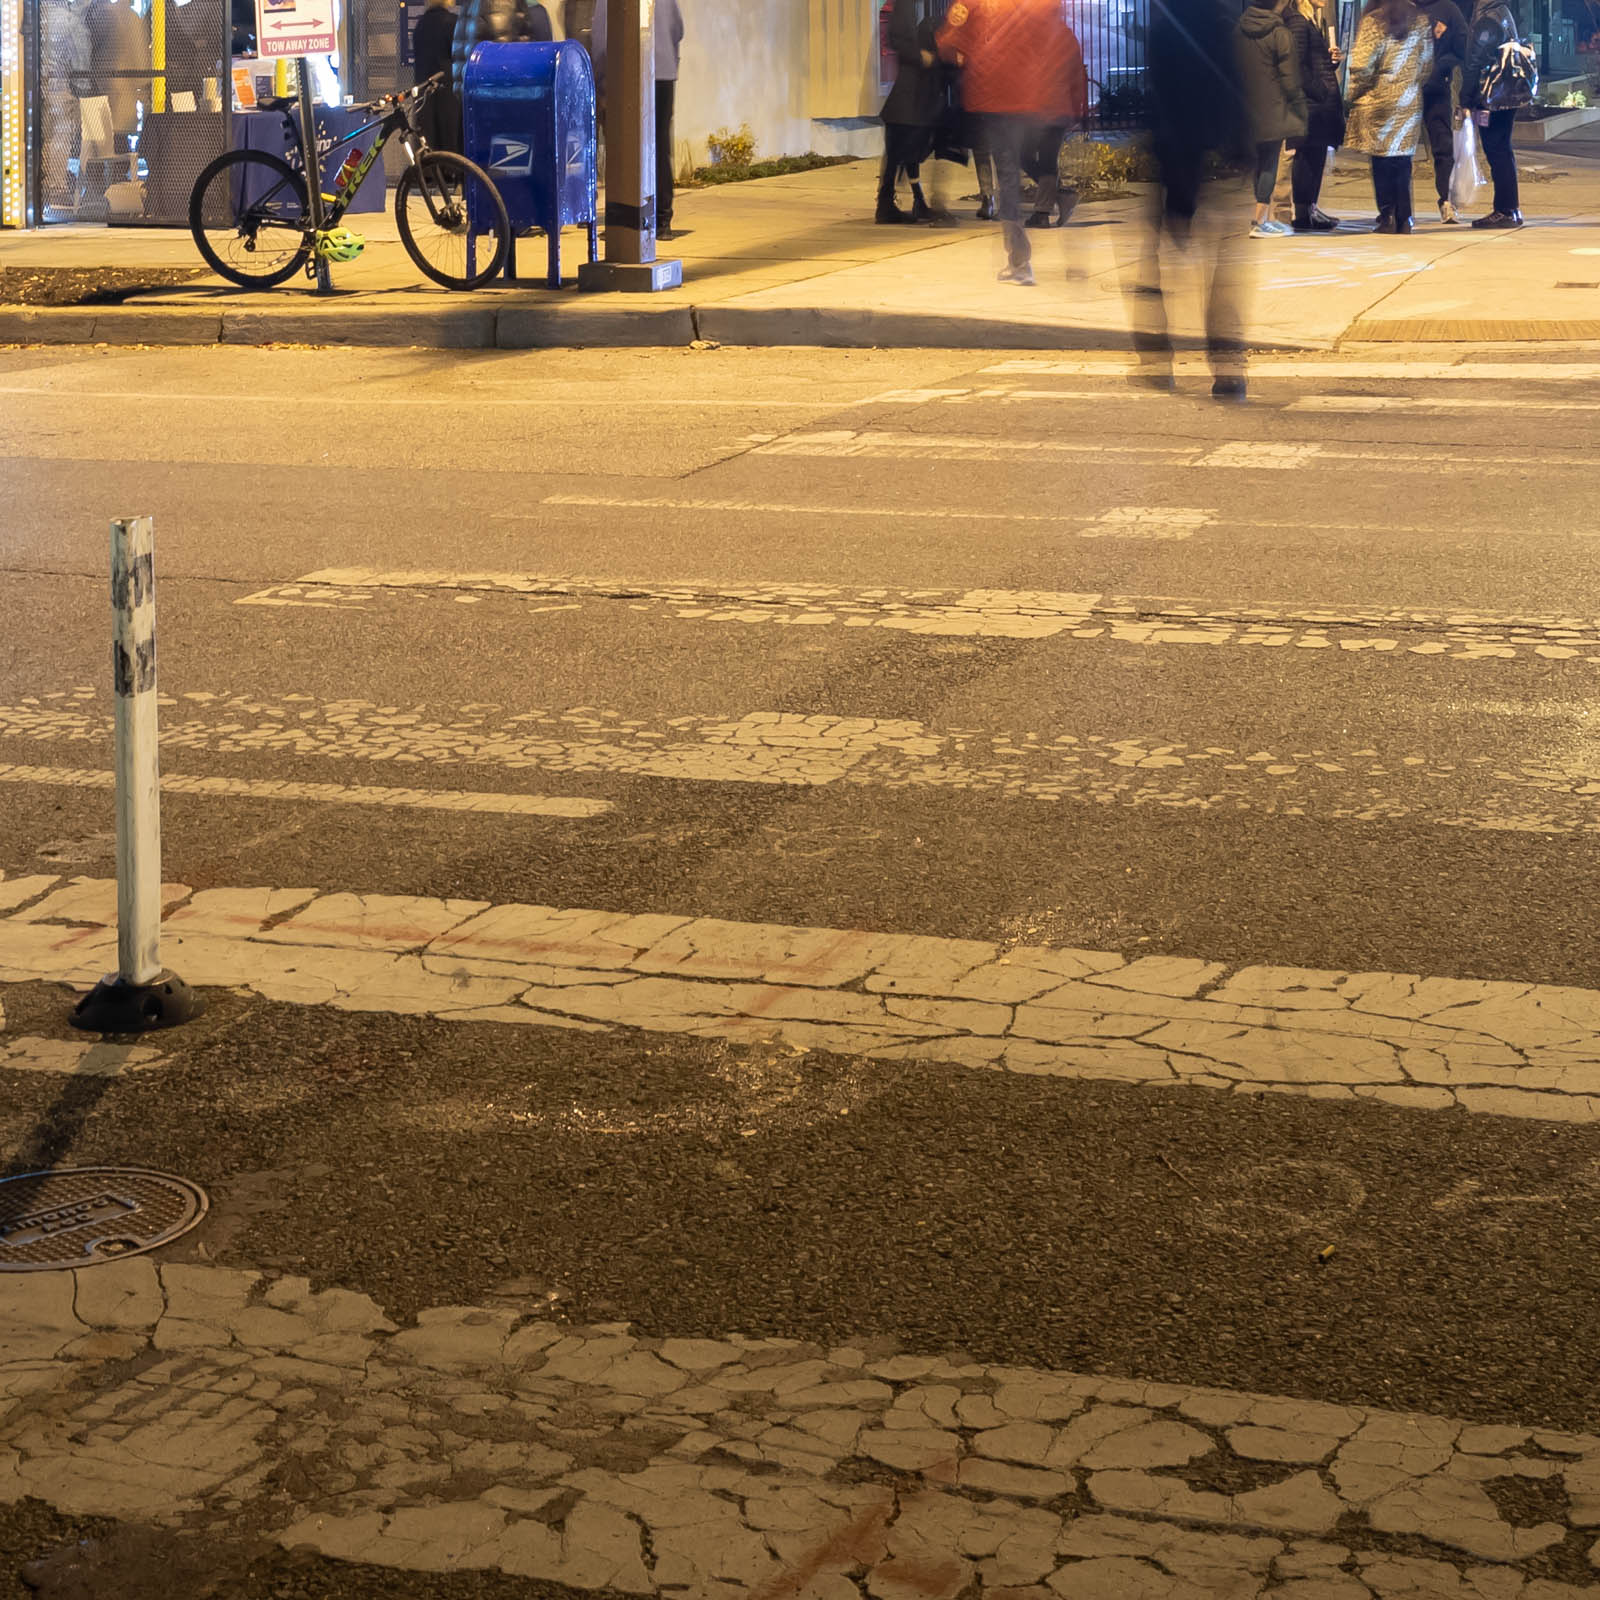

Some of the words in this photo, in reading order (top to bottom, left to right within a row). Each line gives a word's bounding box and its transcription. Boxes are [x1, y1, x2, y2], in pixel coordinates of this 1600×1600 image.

[267, 41, 286, 52] TOW
[286, 39, 308, 51] AWAY
[309, 38, 330, 50] ZONE
